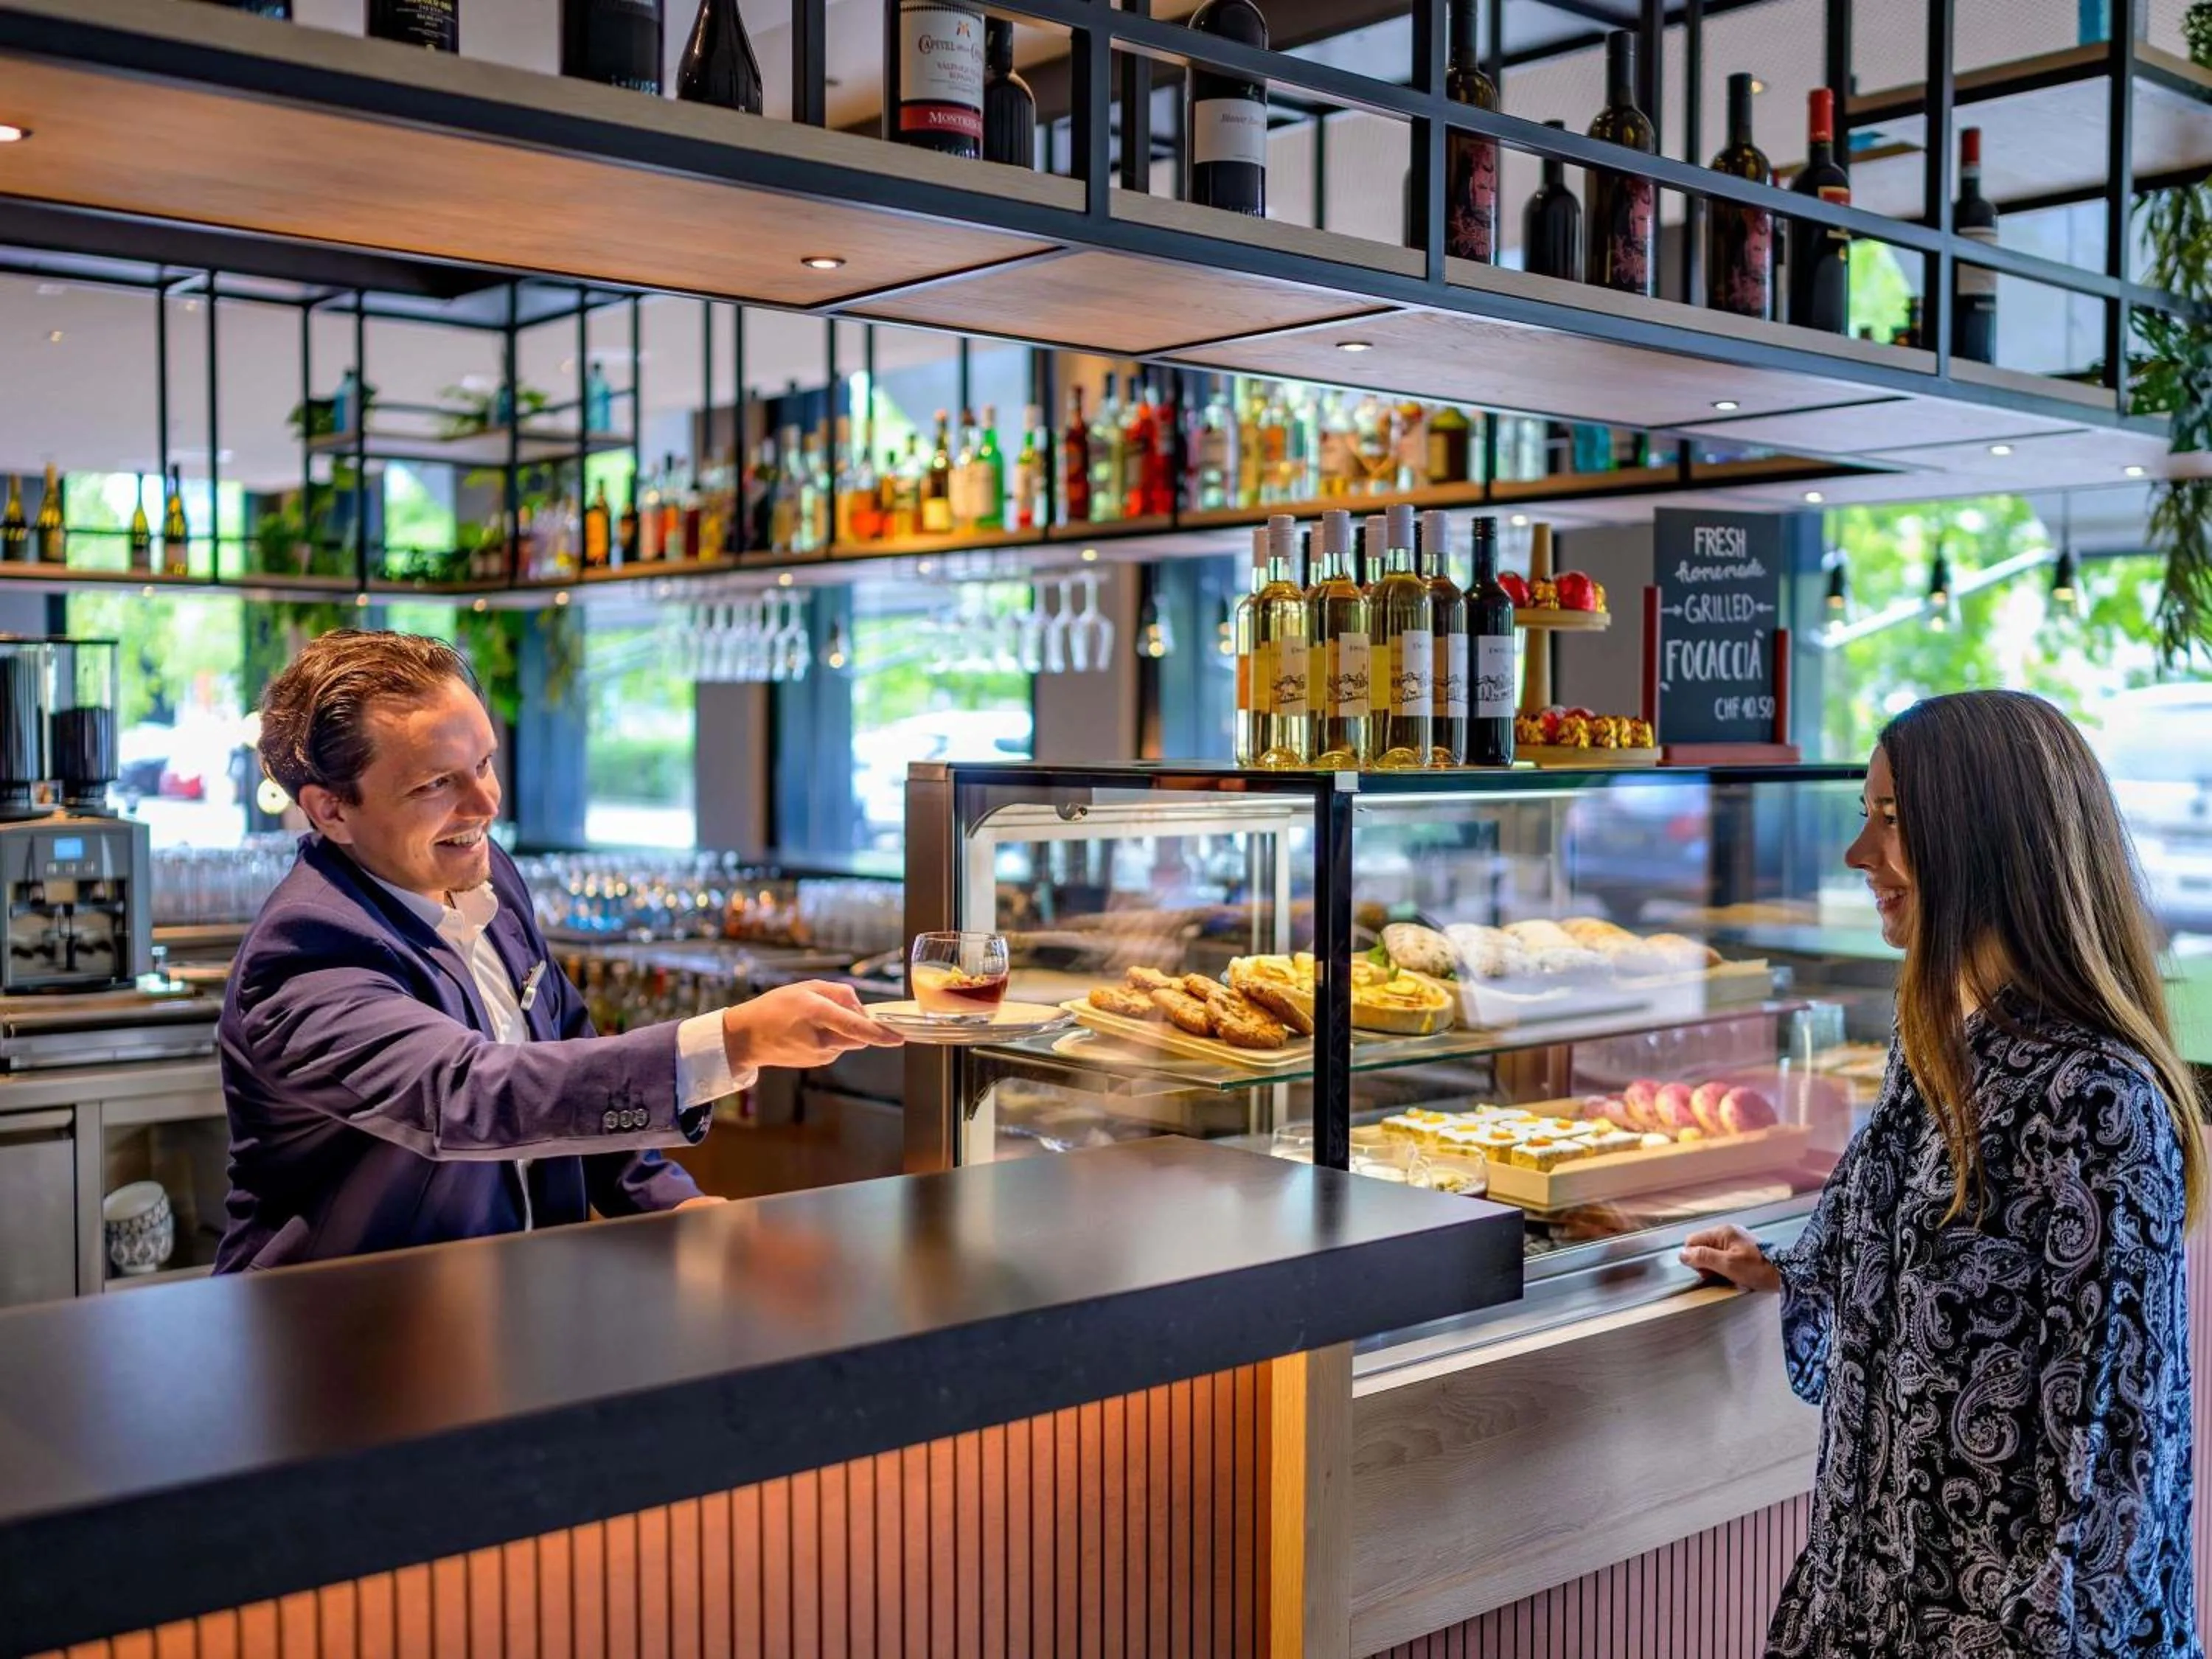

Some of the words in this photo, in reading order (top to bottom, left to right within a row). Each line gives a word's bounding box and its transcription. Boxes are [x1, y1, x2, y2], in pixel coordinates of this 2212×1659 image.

[1694, 526, 1746, 558] FRESH
[1674, 558, 1766, 583] homemade
[1685, 593, 1755, 623] GRILLED
[1714, 697, 1739, 721] CHF
